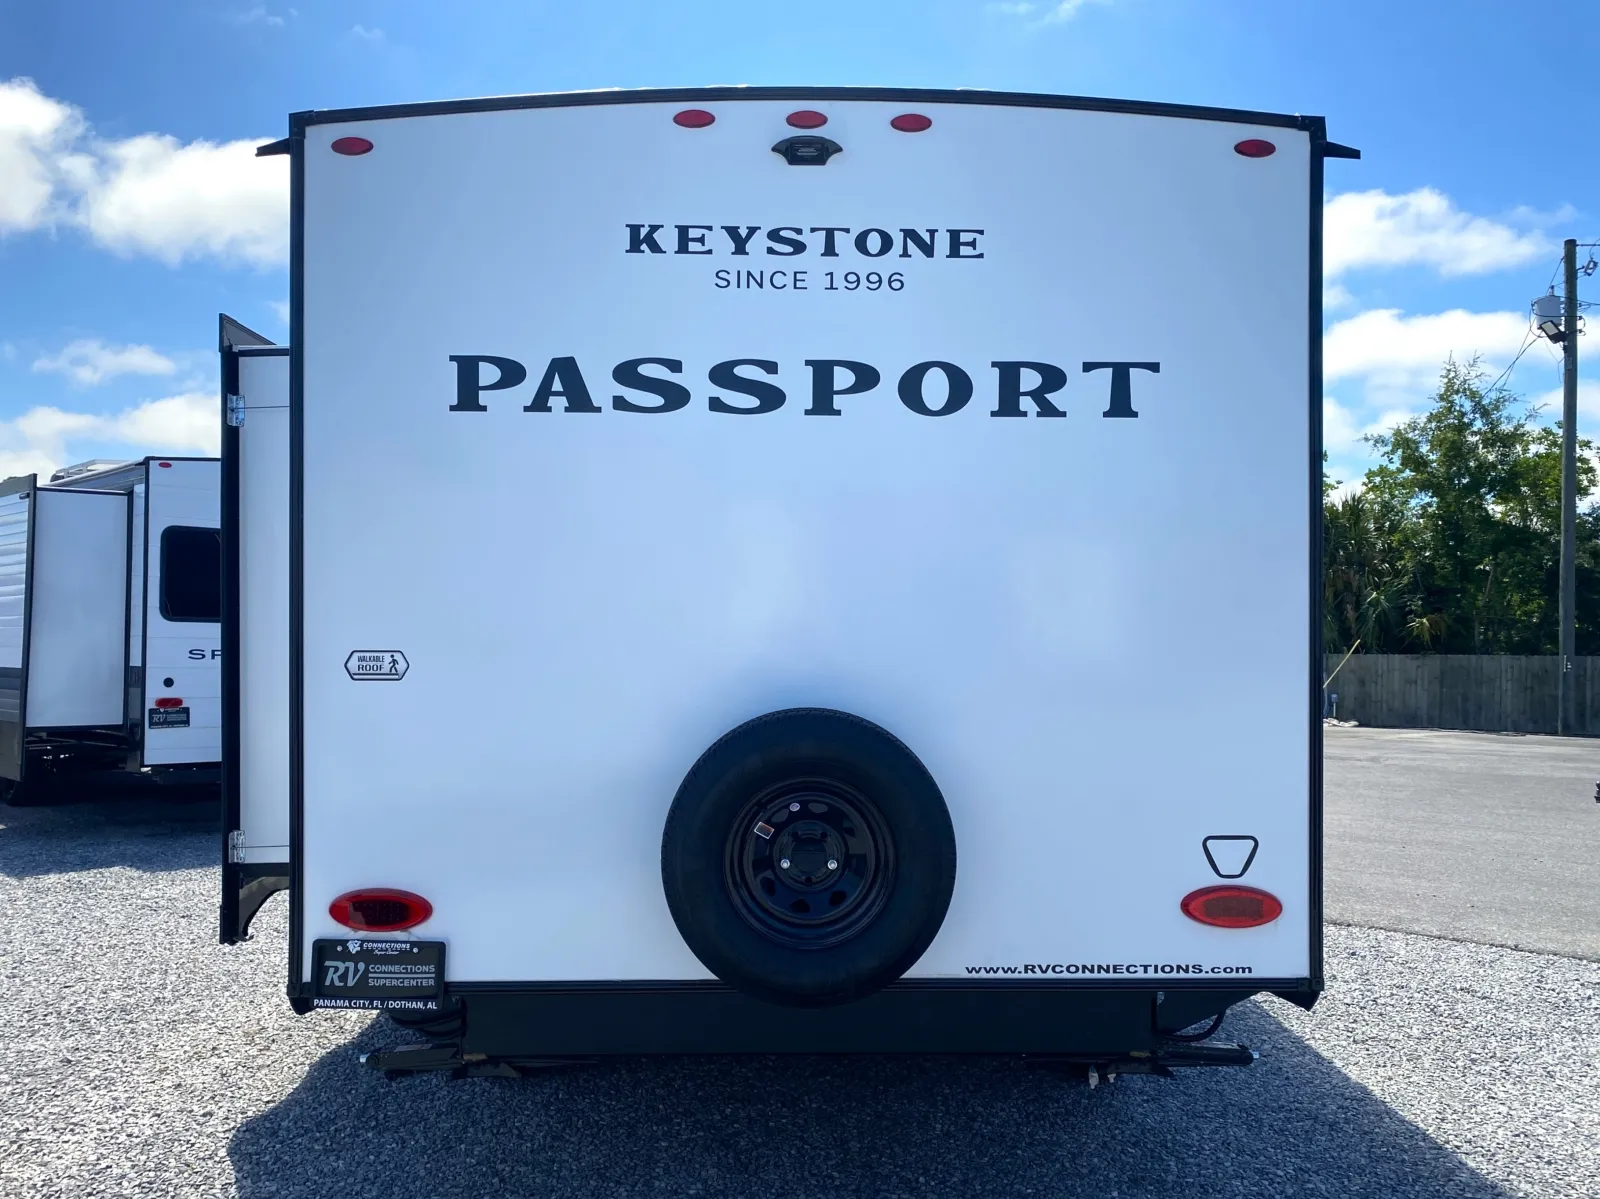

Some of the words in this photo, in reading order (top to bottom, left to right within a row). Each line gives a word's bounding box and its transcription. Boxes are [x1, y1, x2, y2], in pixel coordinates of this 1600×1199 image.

[625, 224, 985, 259] KEYSTONE
[714, 269, 808, 290] SINCE
[824, 271, 905, 291] 1996
[449, 355, 1160, 418] PASSPORT
[357, 655, 385, 663] WALKABLE
[357, 664, 385, 672] ROOF
[324, 960, 366, 987] RV
[368, 964, 435, 973] CONNECTIONS
[965, 963, 1253, 975] www.RVCONNECTIONS.com
[368, 978, 435, 987] SUPERCENTER
[313, 999, 350, 1007] PANAMA
[351, 1000, 372, 1008] CITY,
[373, 1000, 383, 1008] FL
[388, 1001, 426, 1010] DOTHAN,
